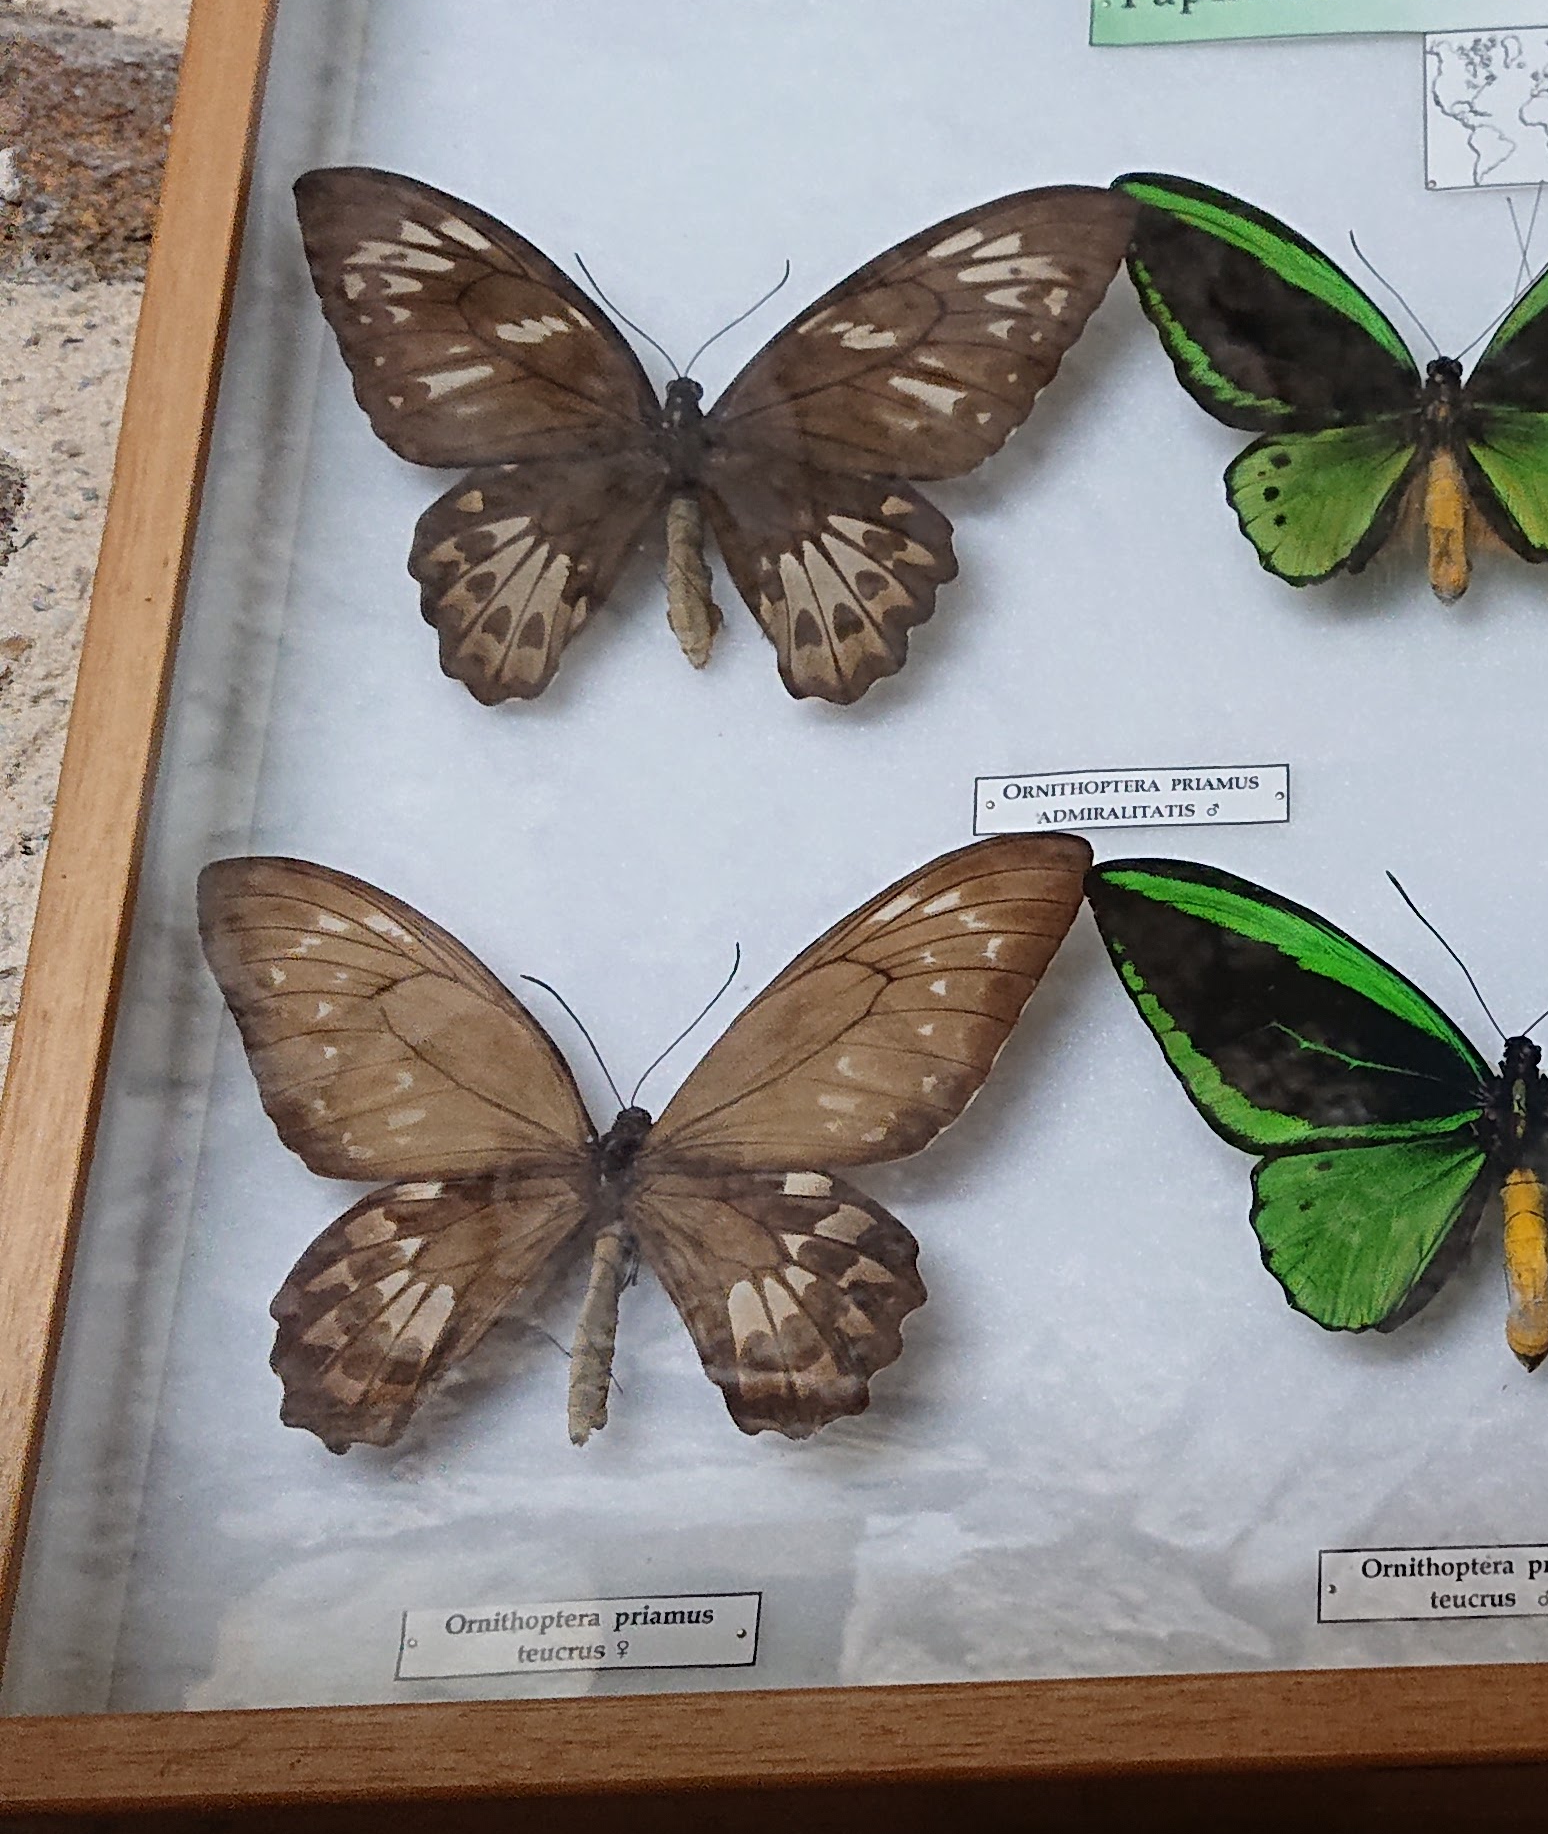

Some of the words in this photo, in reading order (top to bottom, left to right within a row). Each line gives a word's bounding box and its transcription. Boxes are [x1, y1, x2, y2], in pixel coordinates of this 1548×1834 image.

[1002, 779, 1161, 801] ORNITHOPTERA
[1171, 775, 1260, 793] PRIAMUS
[1036, 803, 1196, 825] ADMIRALITATIS
[1361, 1555, 1515, 1583] Ornithoptera
[1430, 1589, 1517, 1609] teucrus
[445, 1610, 601, 1637] Ornithoptera
[614, 1605, 715, 1633] priamus
[517, 1642, 606, 1664] teucrus
